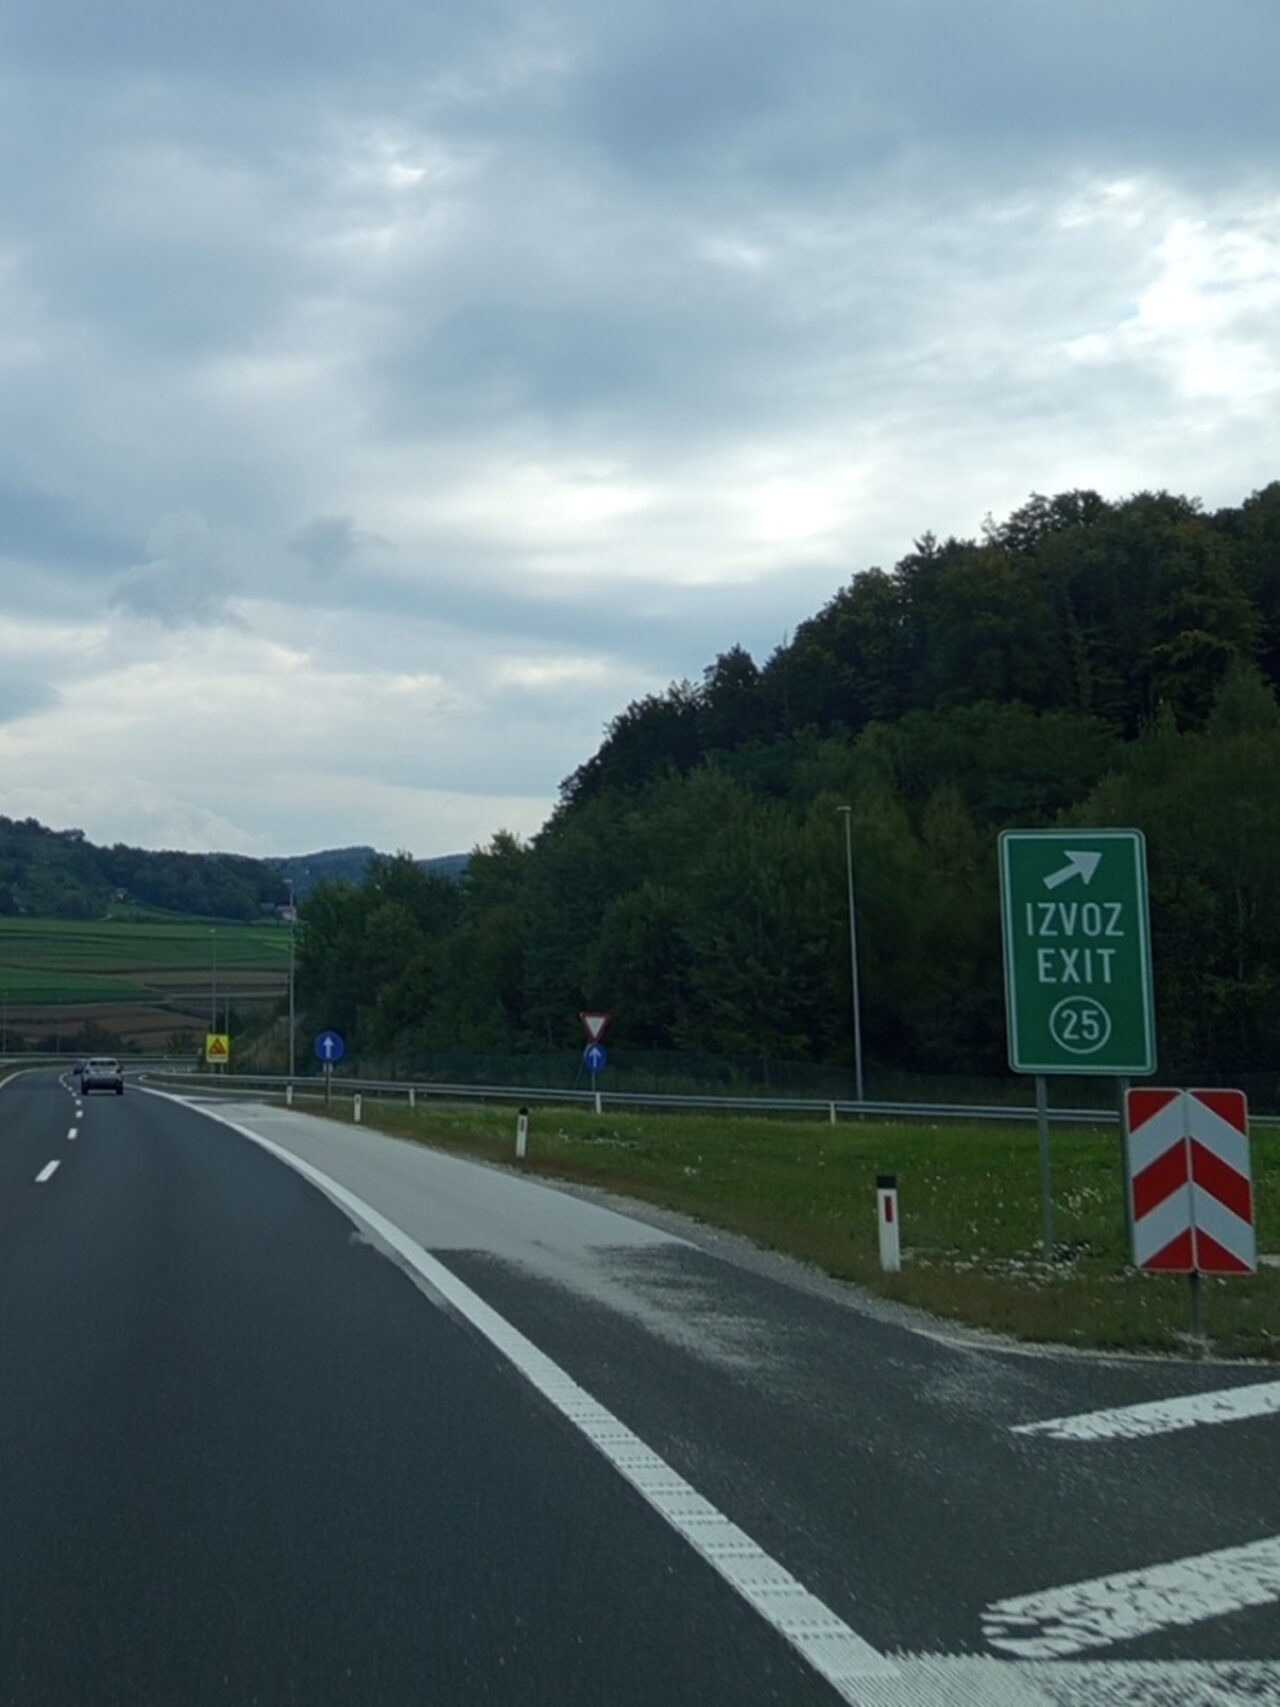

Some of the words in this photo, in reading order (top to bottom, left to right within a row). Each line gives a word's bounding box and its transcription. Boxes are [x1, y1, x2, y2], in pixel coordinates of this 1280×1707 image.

[1026, 902, 1124, 936] IZVOZ
[1037, 948, 1116, 983] EXIT
[1061, 1010, 1100, 1040] 25
